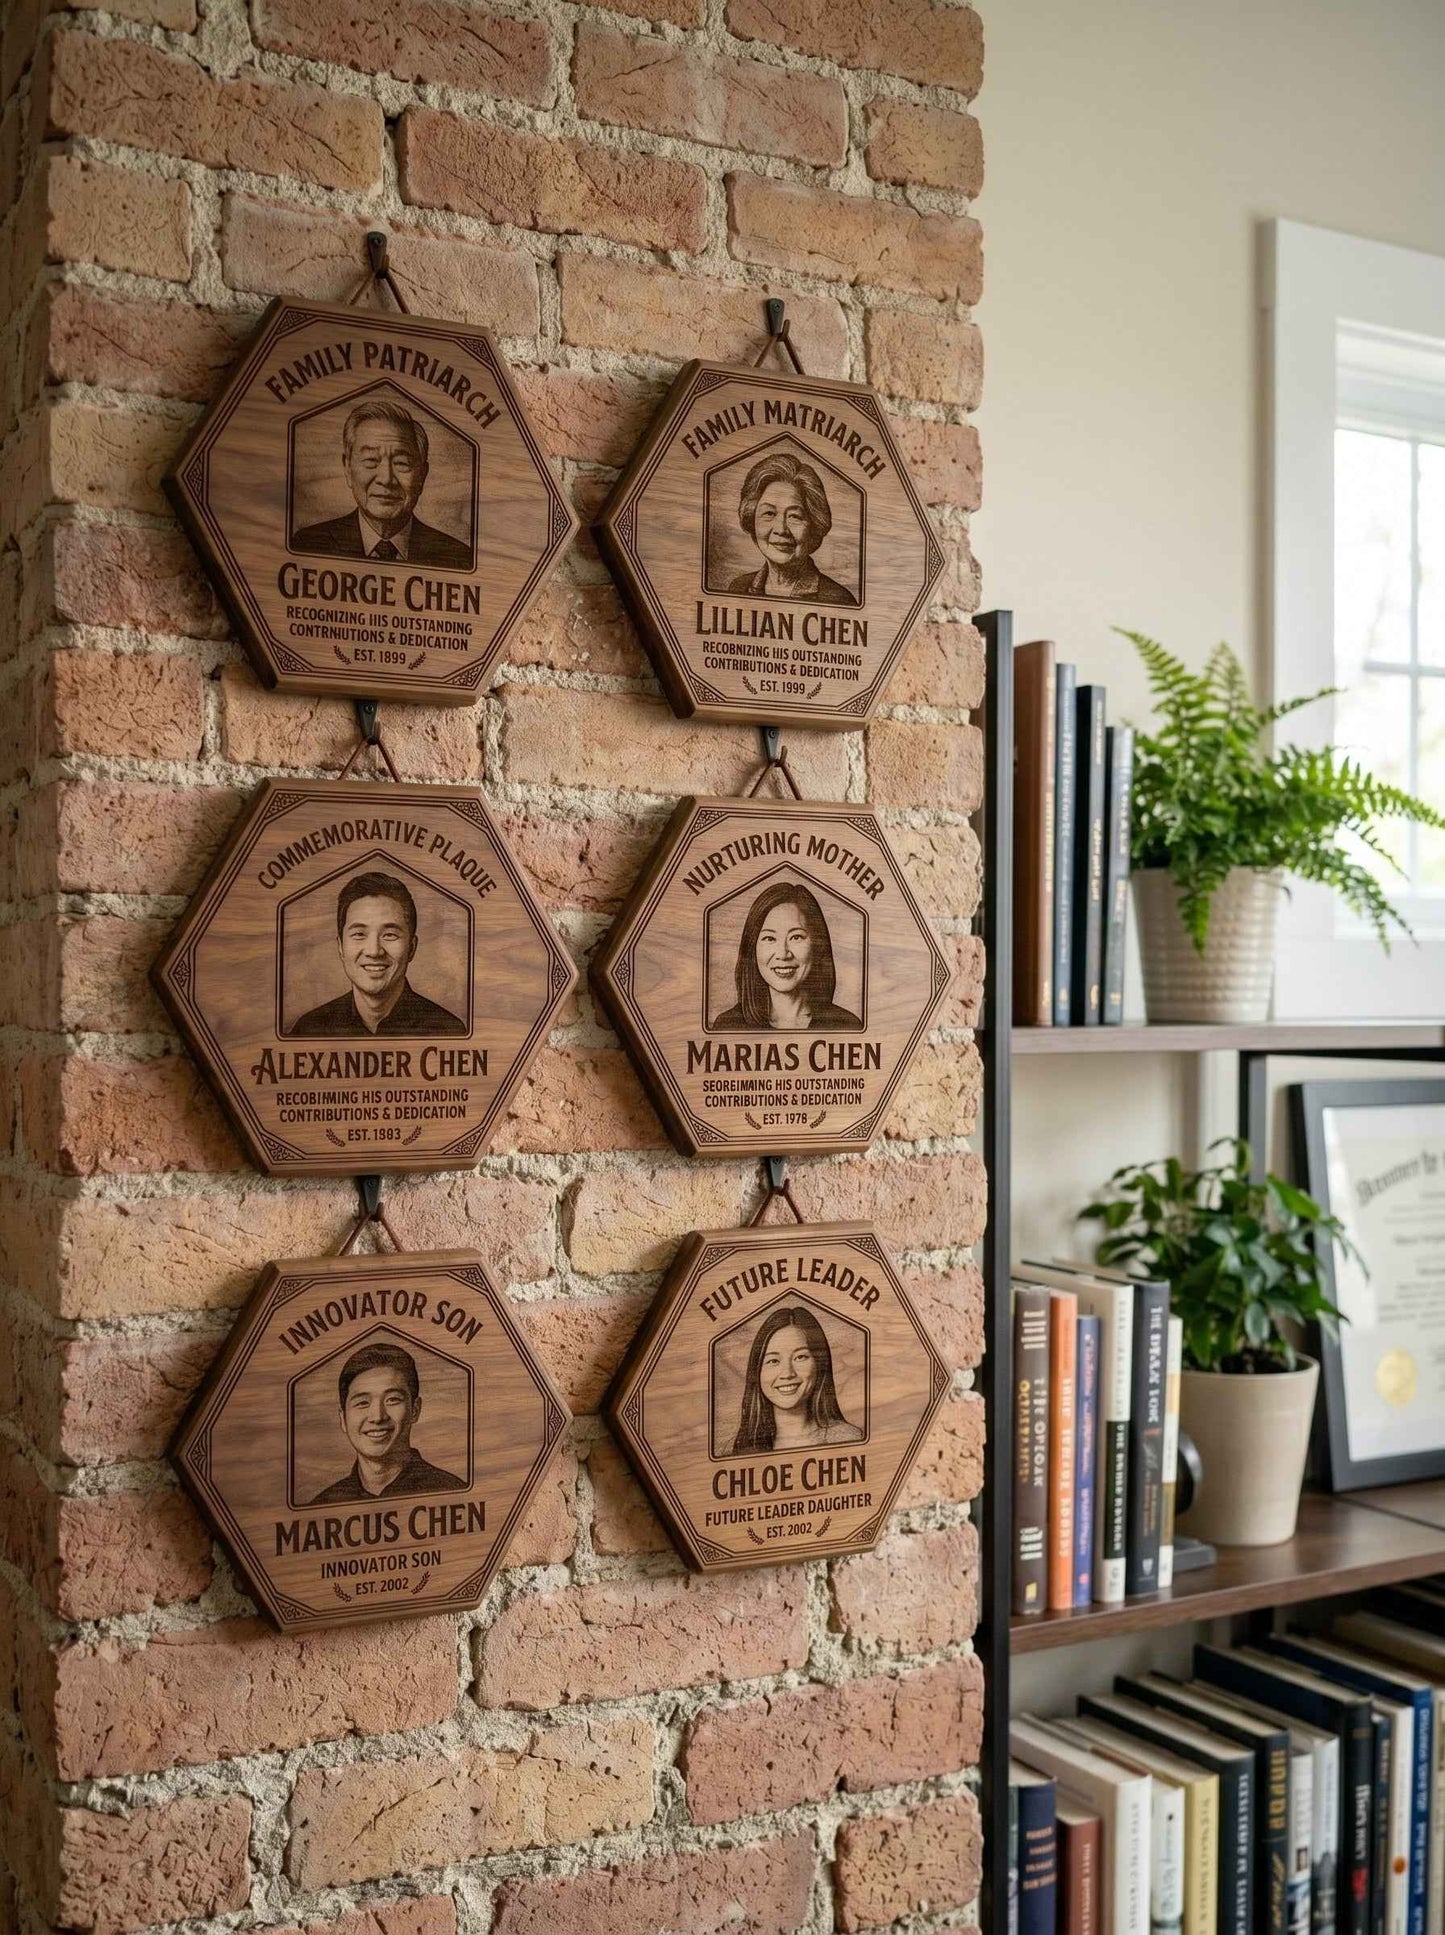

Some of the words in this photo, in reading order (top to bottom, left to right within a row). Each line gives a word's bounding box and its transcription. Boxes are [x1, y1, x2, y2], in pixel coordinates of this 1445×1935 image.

[264, 342, 353, 404] FAMILY
[364, 341, 501, 430] PATRIARCH
[682, 401, 755, 459] FAMILY
[764, 400, 886, 480] MATRIARCH
[278, 562, 395, 606] GEORGE
[405, 576, 480, 615] CHEN
[287, 606, 365, 626] RECOGNIZING
[392, 616, 472, 635] OUTSTANDING
[696, 601, 793, 640] LILLIAN
[802, 613, 868, 647] CHEN
[354, 649, 375, 662] EST.
[380, 651, 405, 664] 1899
[388, 633, 395, 644] &
[401, 633, 468, 651] DEDICATION
[705, 657, 787, 674] CONTRIBUTIONS
[790, 665, 797, 675] &
[800, 665, 859, 681] DEDICATION
[792, 650, 862, 666] OUTSTANDING
[760, 680, 779, 692] EST.
[783, 682, 805, 694] 1999
[258, 819, 427, 890] COMMEMORATIVE
[428, 835, 497, 898] PLAQUE
[682, 832, 800, 896] NURTURING
[807, 835, 885, 901] MOTHER
[251, 1048, 411, 1085] ALEXANDER
[420, 1046, 488, 1081] CHEN
[687, 1041, 799, 1074] MARIAS
[808, 1040, 881, 1072] CHEN
[362, 1090, 381, 1103] HIS
[386, 1089, 468, 1103] OUTSTANDING
[776, 1079, 792, 1090] HIS
[795, 1078, 864, 1089] OUTSTANDING
[280, 1107, 379, 1122] CONTRIBUTIONS
[383, 1108, 390, 1120] &
[395, 1106, 466, 1119] DEDICATION
[705, 1094, 788, 1107] CONTRIBUTIONS
[792, 1094, 798, 1105] &
[801, 1093, 861, 1105] DEDICATION
[764, 1113, 783, 1124] EST.
[786, 1113, 807, 1124] 1978
[348, 1129, 370, 1141] EST.
[699, 1258, 789, 1322] FUTURE
[797, 1258, 881, 1312] LEADER
[278, 1290, 428, 1355] INNOVATOR
[431, 1300, 483, 1346] SON
[712, 1464, 793, 1499] CHLOE
[801, 1455, 865, 1490] CHEN
[706, 1508, 754, 1526] FUTURE
[758, 1502, 804, 1520] LEADER
[808, 1493, 871, 1513] DAUGHTER
[275, 1511, 399, 1556] MARCUS
[408, 1501, 485, 1540] CHEN
[767, 1527, 785, 1538] EST.
[788, 1523, 812, 1536] 2002
[321, 1555, 407, 1579] INNOVATOR
[412, 1550, 441, 1568] SON
[356, 1583, 377, 1595] EST.
[381, 1578, 408, 1592] 2002
